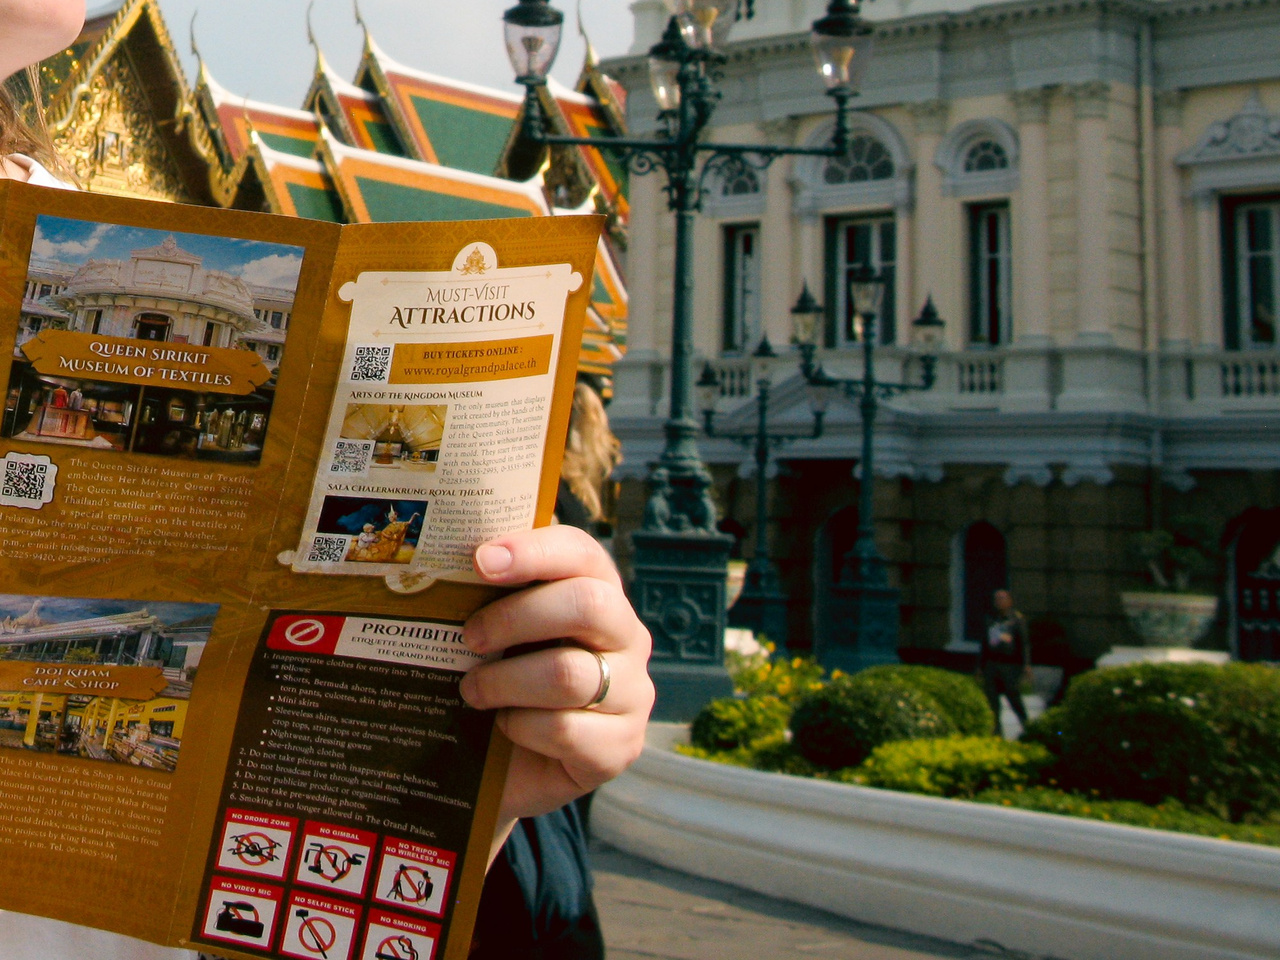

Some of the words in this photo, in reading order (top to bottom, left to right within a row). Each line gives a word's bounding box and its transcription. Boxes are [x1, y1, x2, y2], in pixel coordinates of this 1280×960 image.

[426, 282, 510, 305] MUST-VISIT
[389, 301, 536, 329] ATTRACTIONS
[89, 341, 146, 357] QUEEN
[149, 348, 209, 363] SIRIKIT
[423, 350, 444, 360] BUY
[445, 348, 485, 359] TICKETS
[486, 346, 518, 357] ONLINE
[59, 357, 128, 374] MUSEUM
[133, 365, 155, 377] OF
[157, 368, 231, 385] TEXTILES
[403, 358, 537, 379] www.royalgrandpalace.th
[350, 390, 372, 400] ARTS
[374, 391, 387, 399] OF
[404, 391, 447, 401] KINGDOM
[447, 390, 483, 400] MUSEUM
[453, 402, 467, 411] The
[467, 401, 483, 411] only
[484, 400, 509, 408] museum
[510, 397, 523, 406] that
[523, 395, 546, 405] displays
[69, 457, 88, 467] The
[91, 460, 123, 471] Queen
[125, 464, 157, 474] Sirikit
[160, 468, 200, 478] Museum
[202, 472, 214, 480] of
[216, 473, 254, 484] Textiles
[327, 483, 350, 491] SALA
[351, 484, 428, 496] CHALERMKRUNG
[428, 488, 458, 497] ROYAL
[458, 488, 495, 497] THEATRE
[35, 667, 63, 676] DOI
[67, 668, 110, 678] KHAM
[64, 679, 78, 689] &
[80, 680, 120, 690] SHOP
[276, 694, 297, 704] Mini
[297, 697, 319, 707] skirts
[266, 739, 314, 754] See-through
[316, 747, 345, 758] clothes
[238, 746, 246, 755] 2.
[248, 748, 261, 757] Do
[262, 751, 277, 760] not
[278, 753, 295, 762] take
[296, 756, 327, 771] pictures
[329, 761, 347, 770] with
[348, 765, 401, 779] inappropriate
[402, 773, 438, 787] behavior.
[233, 769, 242, 778] 4.
[243, 770, 256, 779] Do
[257, 774, 271, 782] not
[272, 776, 307, 787] publicize
[308, 782, 339, 795] product
[351, 790, 400, 804] organization.
[236, 757, 244, 766] 3.
[245, 759, 258, 768] Do
[259, 763, 273, 771] not
[274, 764, 311, 776] broadcast
[312, 770, 328, 779] live
[328, 774, 359, 790] through
[360, 779, 383, 788] social
[384, 784, 408, 794] media
[409, 789, 471, 808] communication.
[231, 780, 239, 789] 5.
[241, 782, 254, 791] Do
[254, 785, 269, 793] not
[270, 787, 288, 796] take
[288, 791, 337, 805] pre-wedding
[338, 798, 367, 810] photos.
[228, 791, 237, 800] 6.
[238, 793, 274, 807] Smoking
[274, 799, 282, 807] is
[295, 803, 321, 814] longer
[321, 808, 353, 819] allowed
[365, 816, 381, 825] The
[382, 819, 408, 831] Grand
[409, 824, 436, 838] Palace.
[231, 812, 243, 821] NO
[244, 814, 269, 824] DRONE
[270, 817, 291, 828] ZONE
[319, 827, 331, 835] NO
[332, 828, 360, 840] GIMBAL
[385, 845, 397, 854] NO
[397, 847, 435, 864] WIRELESS
[436, 857, 451, 867] MIC
[398, 841, 410, 850] NO
[410, 843, 438, 857] TRIPOD
[221, 881, 232, 889] NO
[233, 883, 256, 893] VIDEO
[258, 888, 272, 896] MIC
[294, 895, 306, 903] NO
[306, 897, 332, 910] SELFIE
[333, 903, 355, 915] STICK
[379, 915, 391, 924] NO
[392, 917, 427, 933] SMOKING
